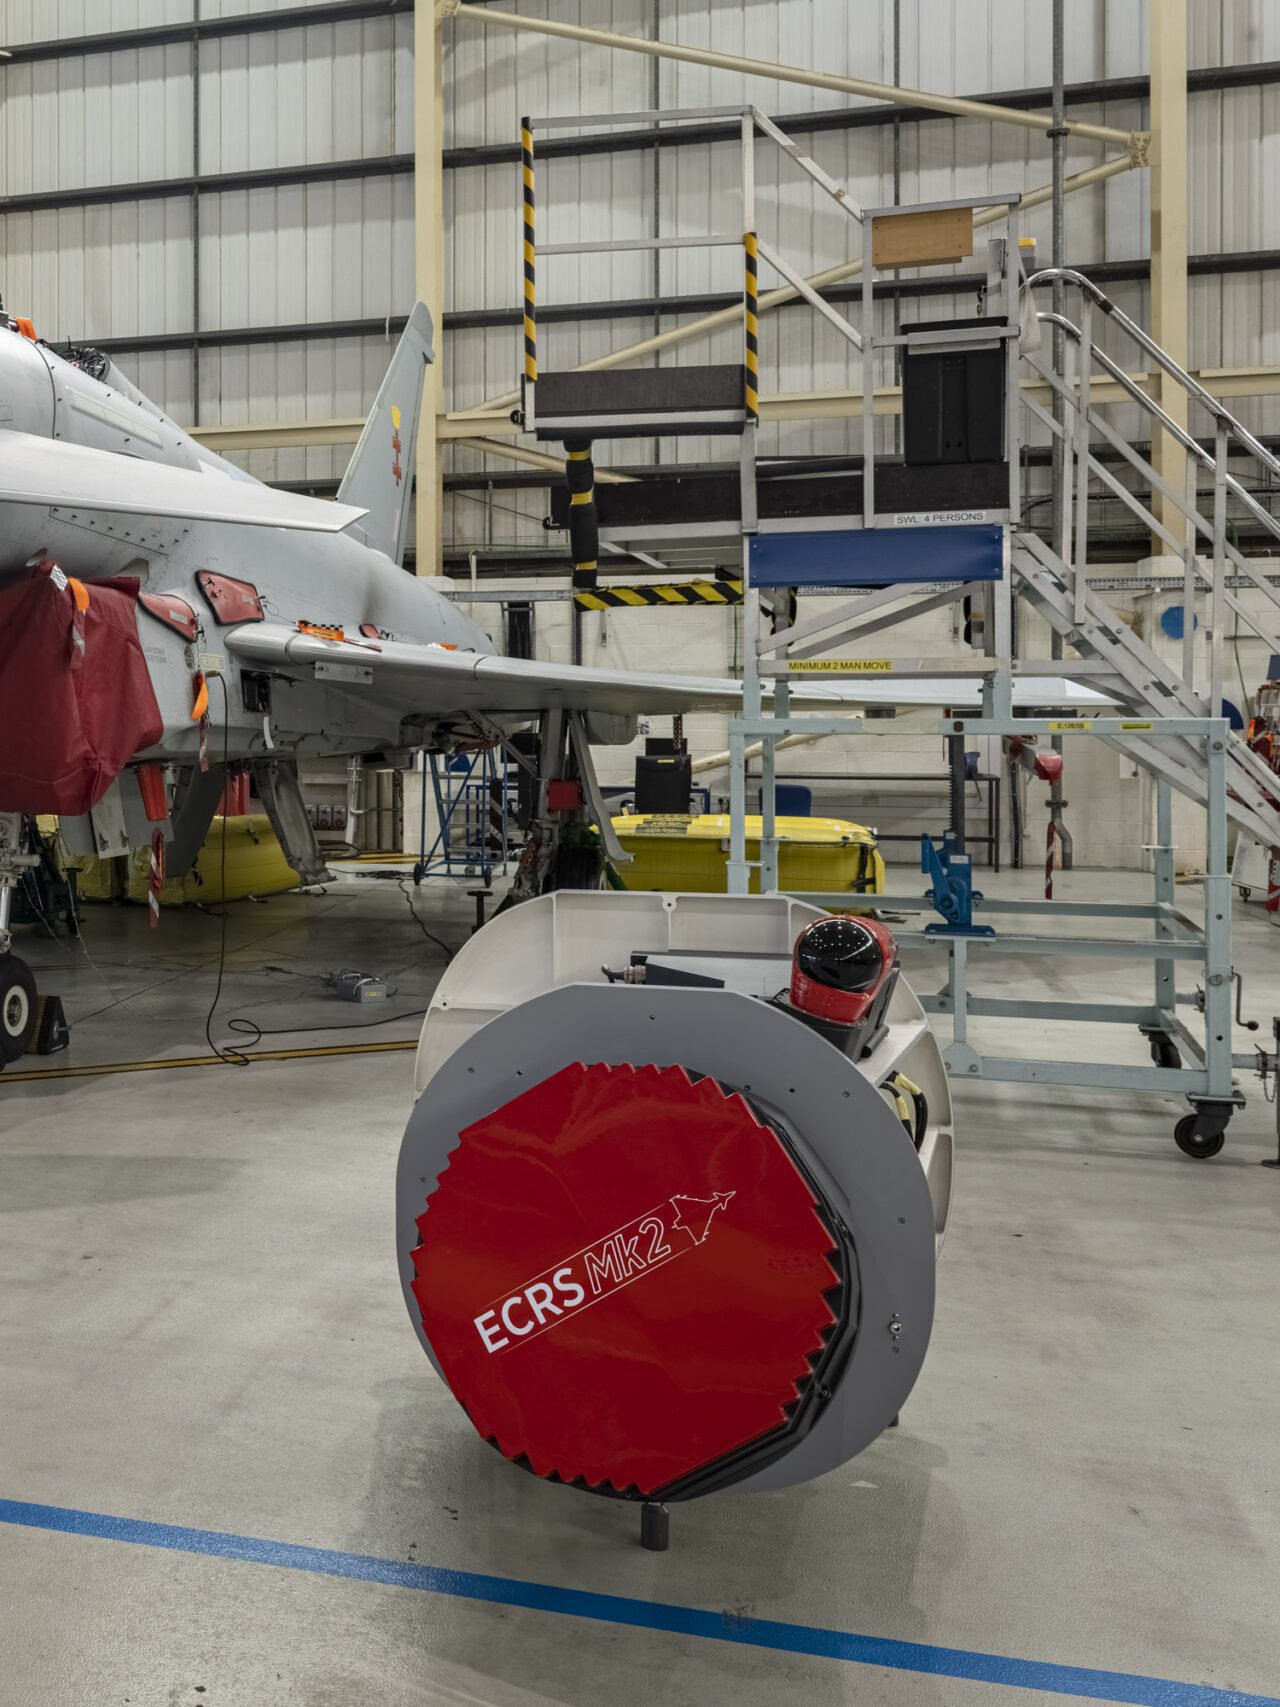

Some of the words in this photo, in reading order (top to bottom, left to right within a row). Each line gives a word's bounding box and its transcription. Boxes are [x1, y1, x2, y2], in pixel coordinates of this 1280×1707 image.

[924, 514, 930, 522] 4
[933, 512, 983, 521] PERSONS
[788, 661, 831, 670] MINIMUM
[832, 661, 839, 670] 2
[840, 661, 862, 670] MAN
[863, 661, 892, 670] MOVE
[473, 1267, 586, 1354] ECRS
[583, 1216, 672, 1295] Mk2
